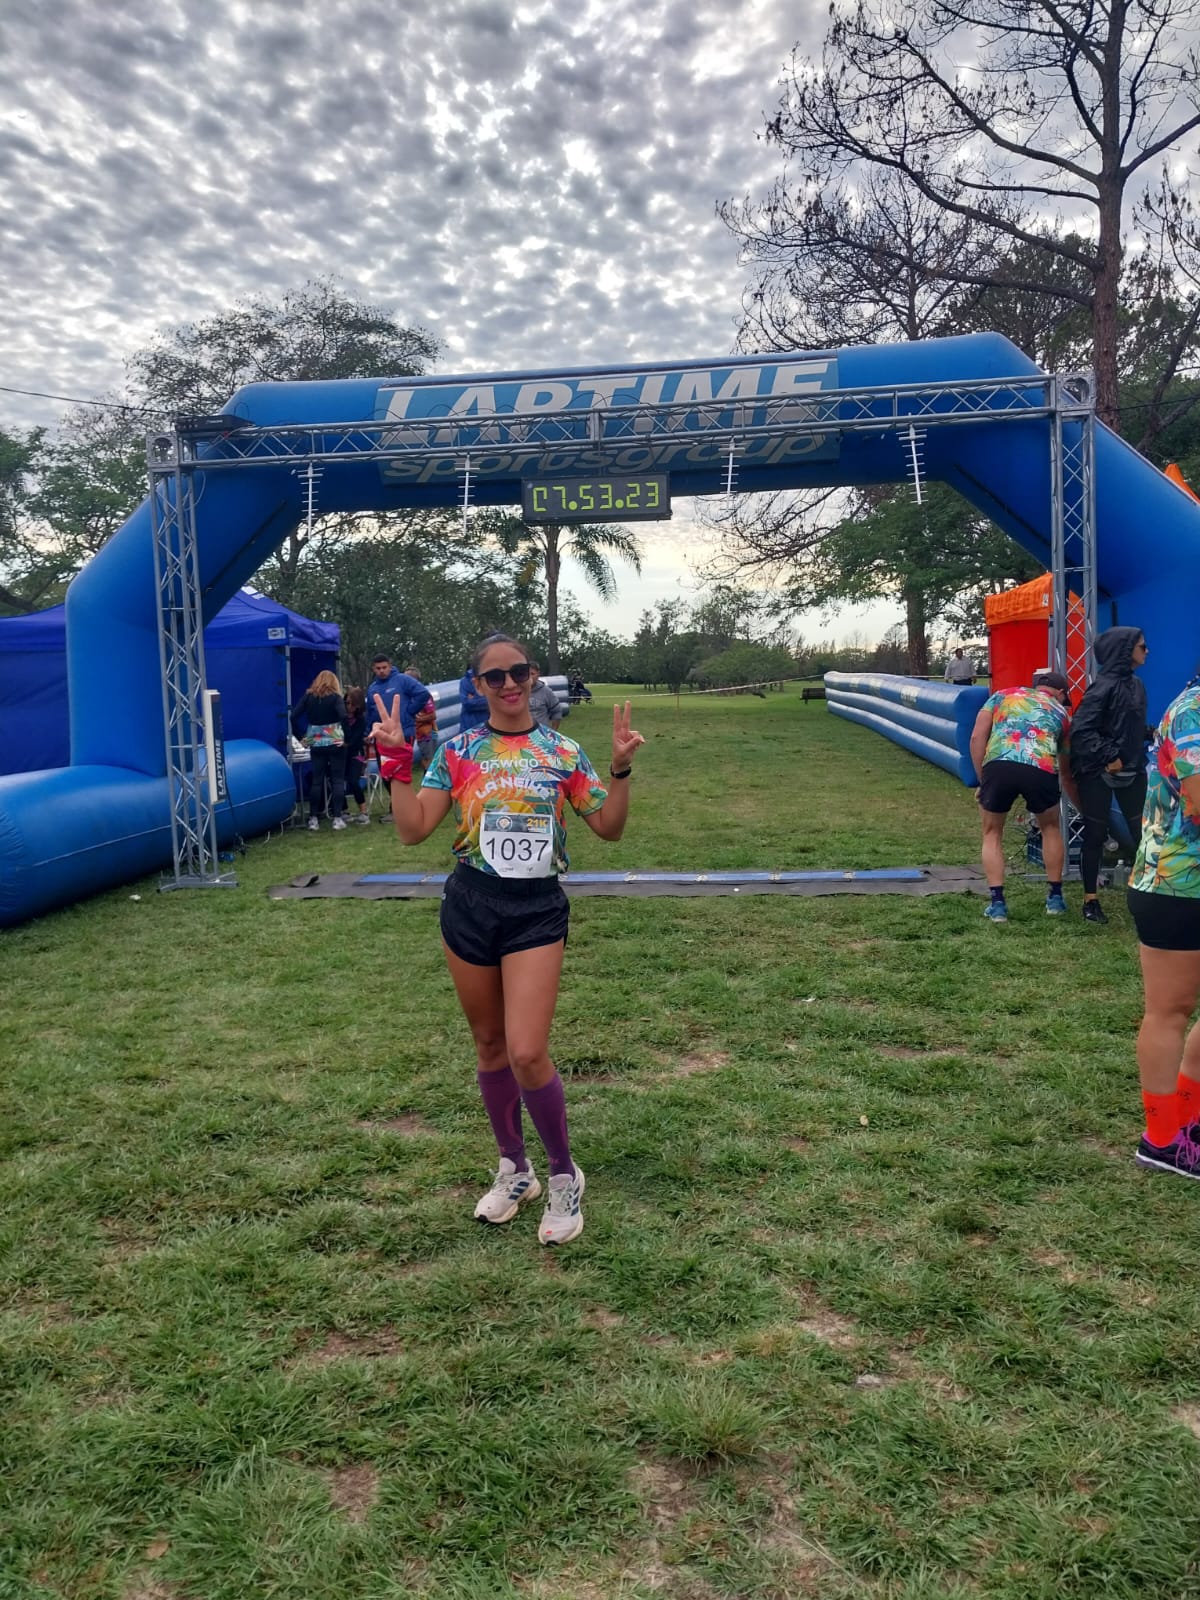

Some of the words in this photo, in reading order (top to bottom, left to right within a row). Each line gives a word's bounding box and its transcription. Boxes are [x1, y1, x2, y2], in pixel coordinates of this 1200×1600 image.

[382, 362, 829, 445] LAPTIME
[215, 739, 225, 795] LAPTIME
[486, 838, 549, 862] 1037
